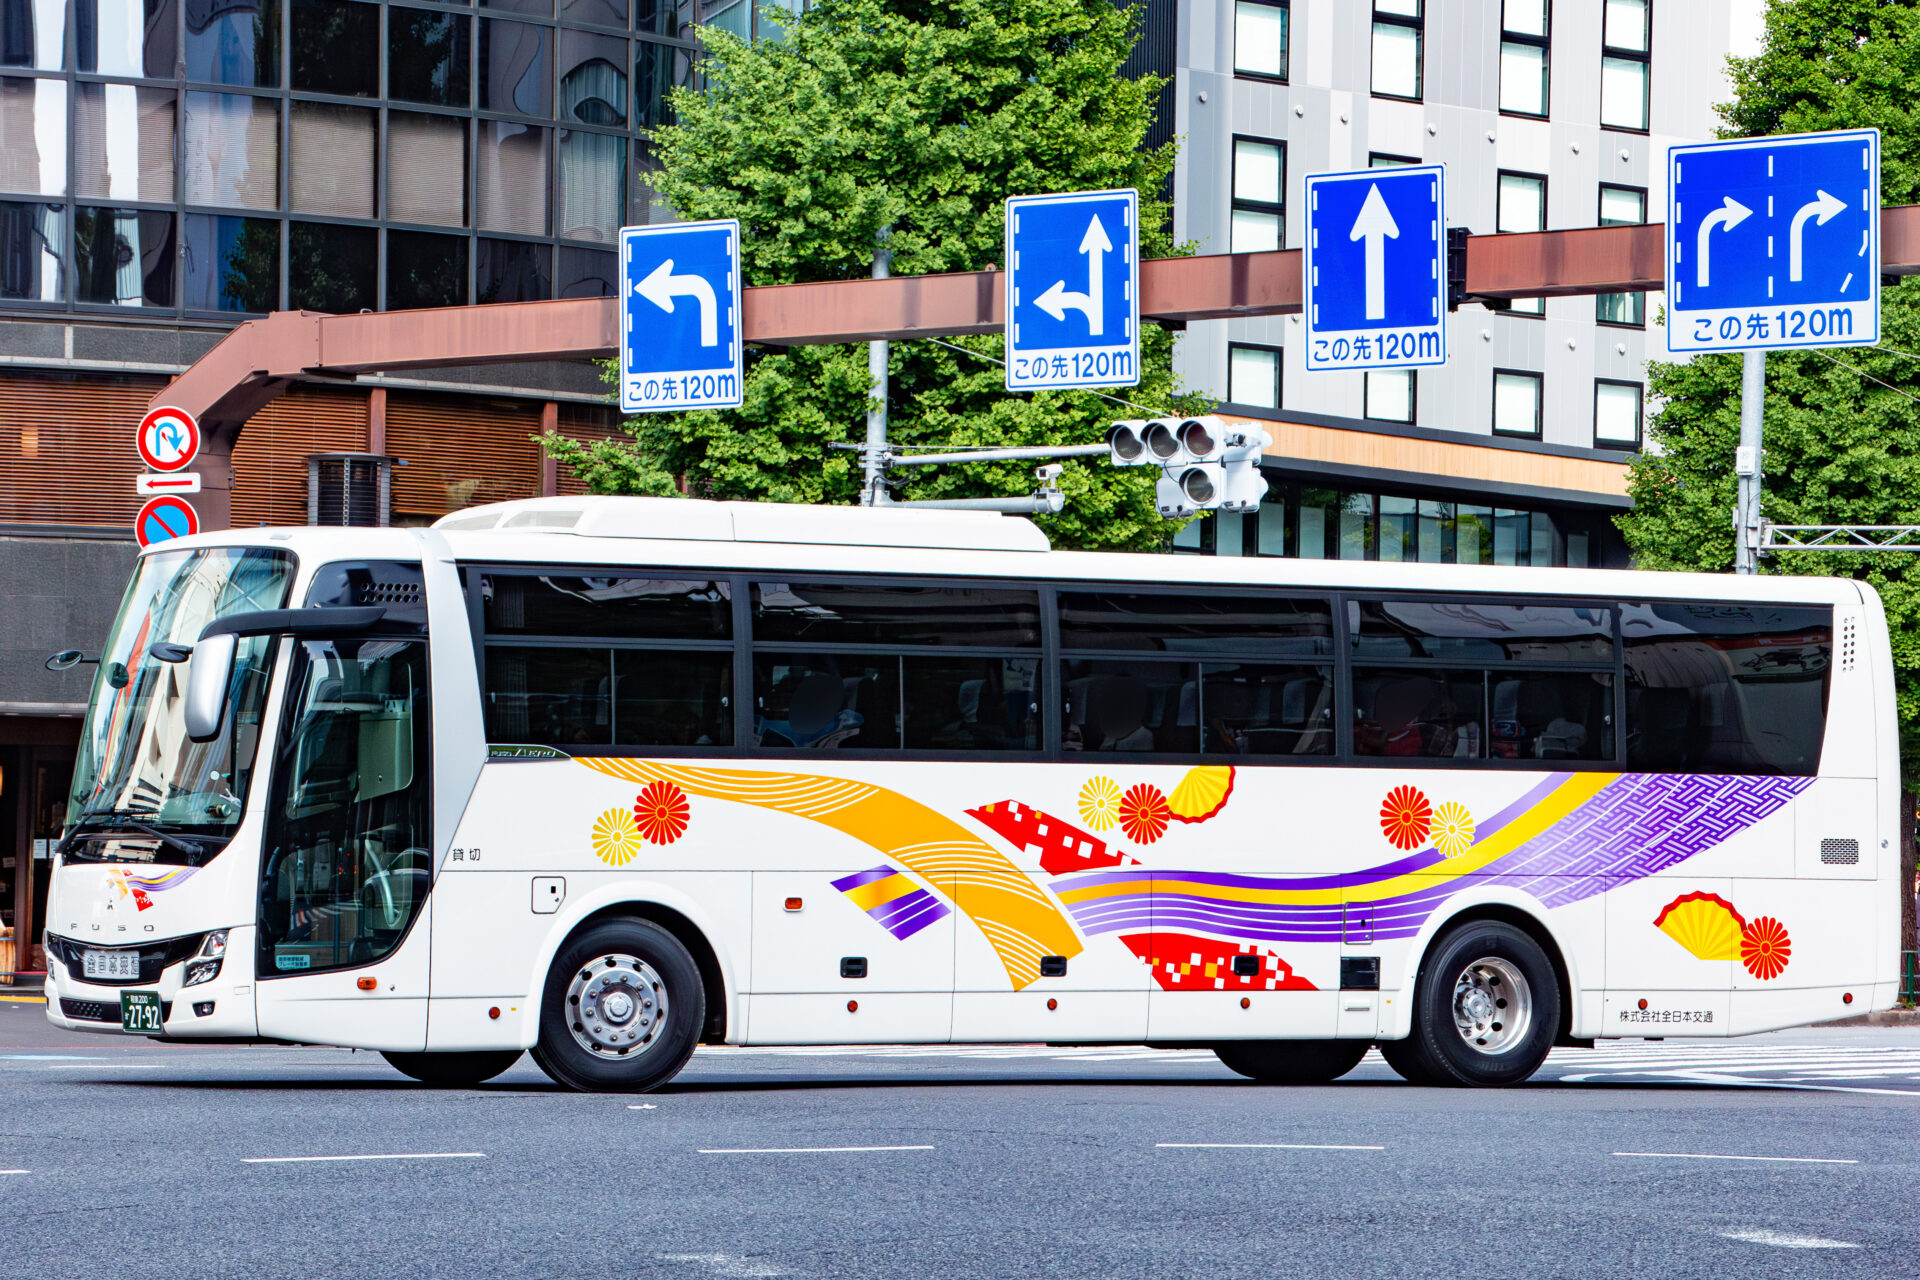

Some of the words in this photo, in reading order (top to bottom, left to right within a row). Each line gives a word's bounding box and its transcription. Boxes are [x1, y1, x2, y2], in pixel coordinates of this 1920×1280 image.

[1694, 307, 1853, 342] この先120m
[1314, 331, 1440, 362] この先120m
[1015, 350, 1132, 380] この先120m
[629, 374, 736, 401] この先120m
[452, 848, 481, 861] 貸切
[70, 923, 155, 932] FUSO
[1619, 1010, 1713, 1023] 株式会社全日本交通
